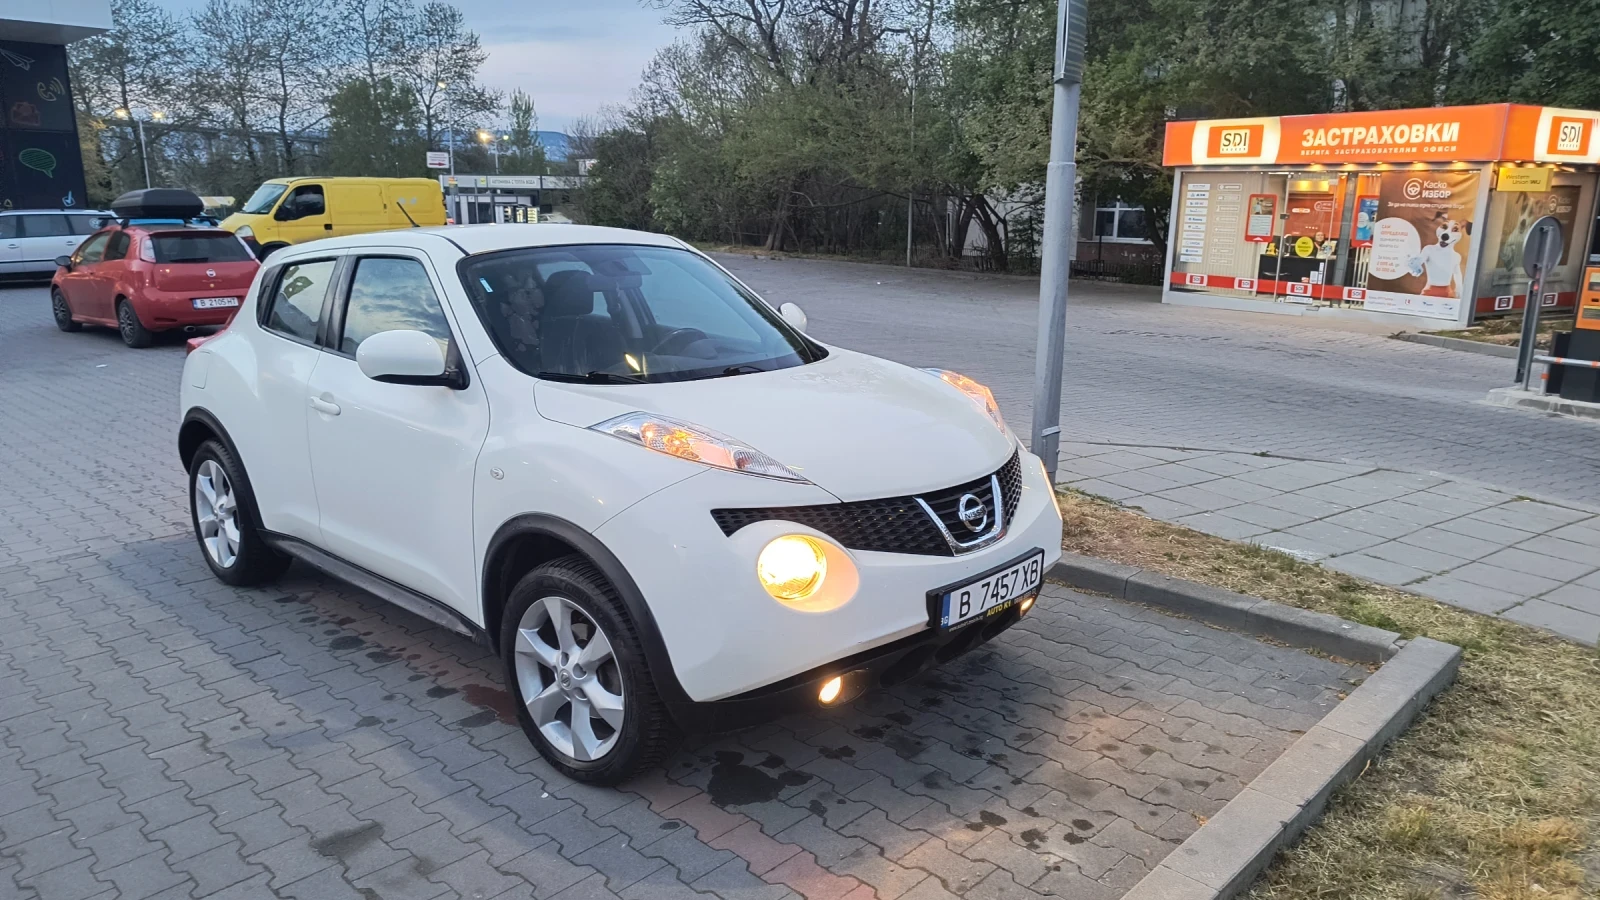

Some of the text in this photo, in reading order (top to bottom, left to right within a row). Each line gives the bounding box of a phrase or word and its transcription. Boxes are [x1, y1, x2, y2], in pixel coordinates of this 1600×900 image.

[1222, 132, 1248, 147] SDI
[1302, 122, 1460, 147] ЗАСТРАХОВКИ
[1560, 125, 1580, 143] SDI
[1334, 146, 1418, 156] ЗАСТРАХОВАТЕЛНИ
[1423, 145, 1457, 153] ОФИСИ
[1423, 180, 1448, 189] Каско
[1422, 190, 1452, 198] ИЗБОР
[960, 590, 970, 620] B
[980, 568, 1020, 610] 7457
[1020, 559, 1038, 591] XB
[986, 604, 1002, 617] AUTO
